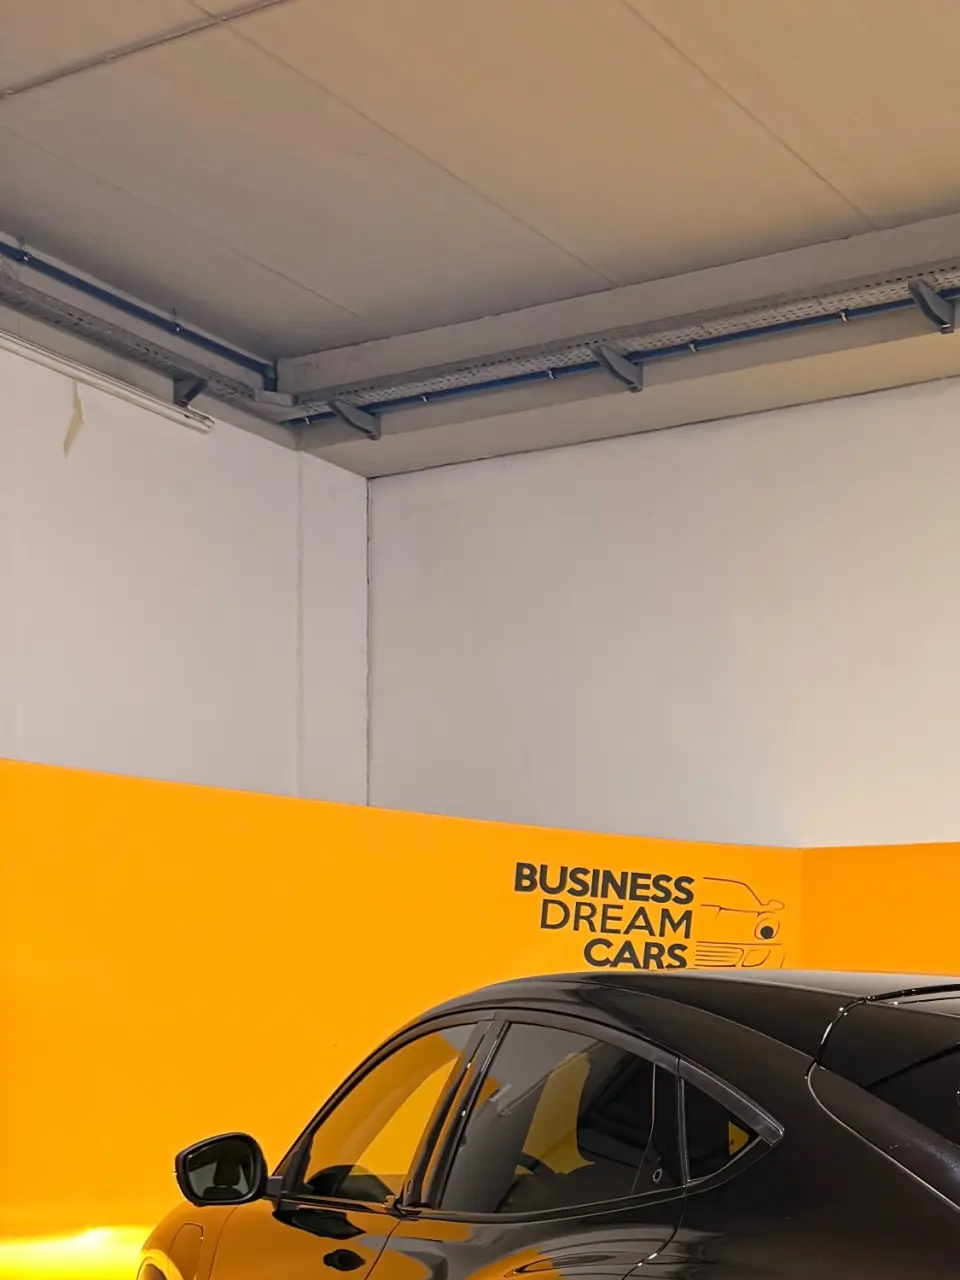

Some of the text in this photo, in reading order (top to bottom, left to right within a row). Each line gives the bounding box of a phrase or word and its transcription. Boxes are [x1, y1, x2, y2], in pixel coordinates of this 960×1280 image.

[514, 862, 695, 905] BUSINESS
[540, 899, 693, 939] DREAM
[583, 938, 688, 970] CARS
